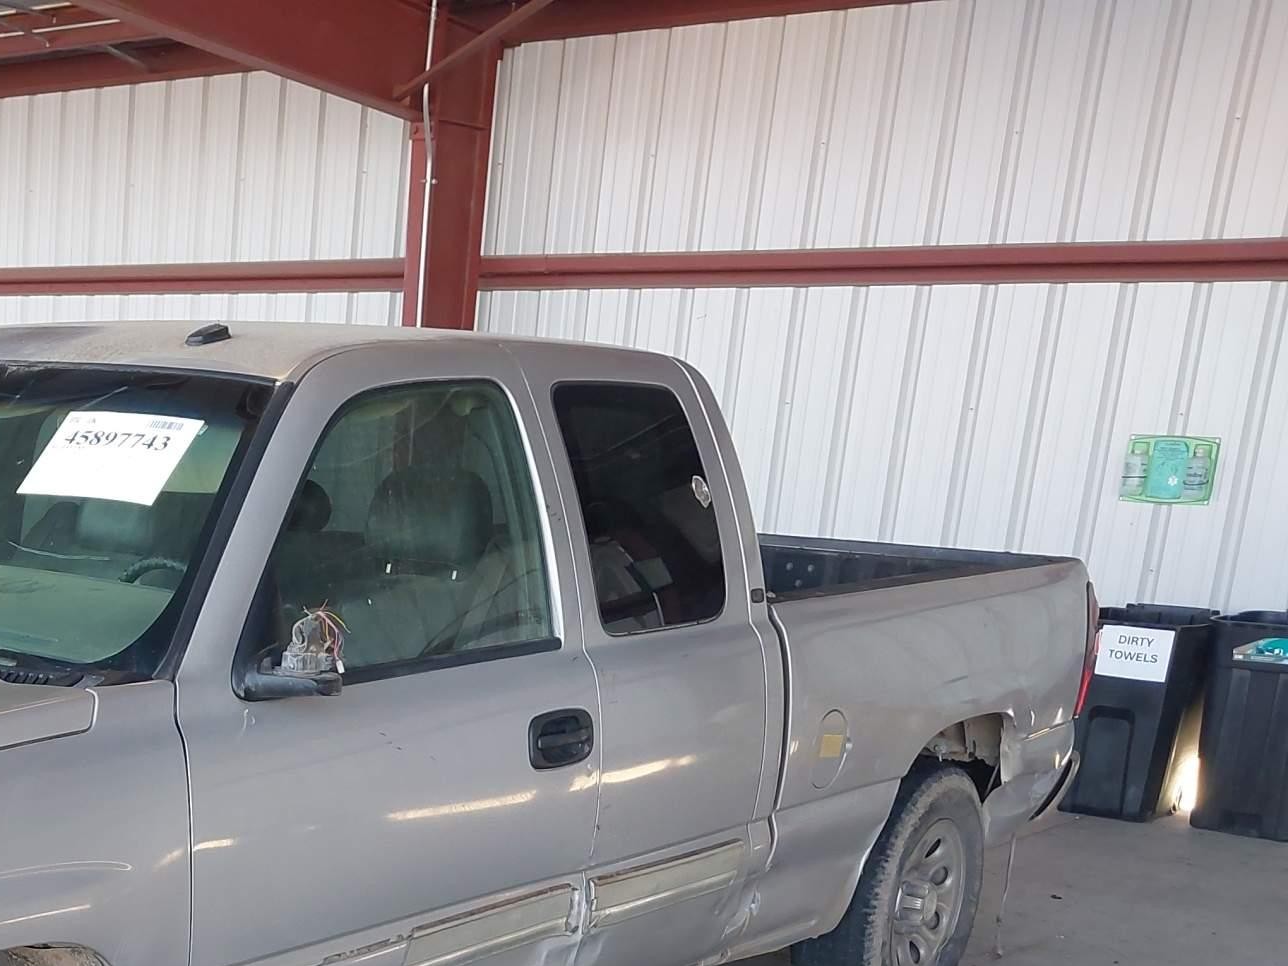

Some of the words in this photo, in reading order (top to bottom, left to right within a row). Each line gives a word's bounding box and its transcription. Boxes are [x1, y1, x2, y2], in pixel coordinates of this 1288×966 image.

[64, 430, 171, 451] 45897743
[1118, 635, 1155, 647] DIRTY
[1109, 649, 1158, 663] TOWELS
